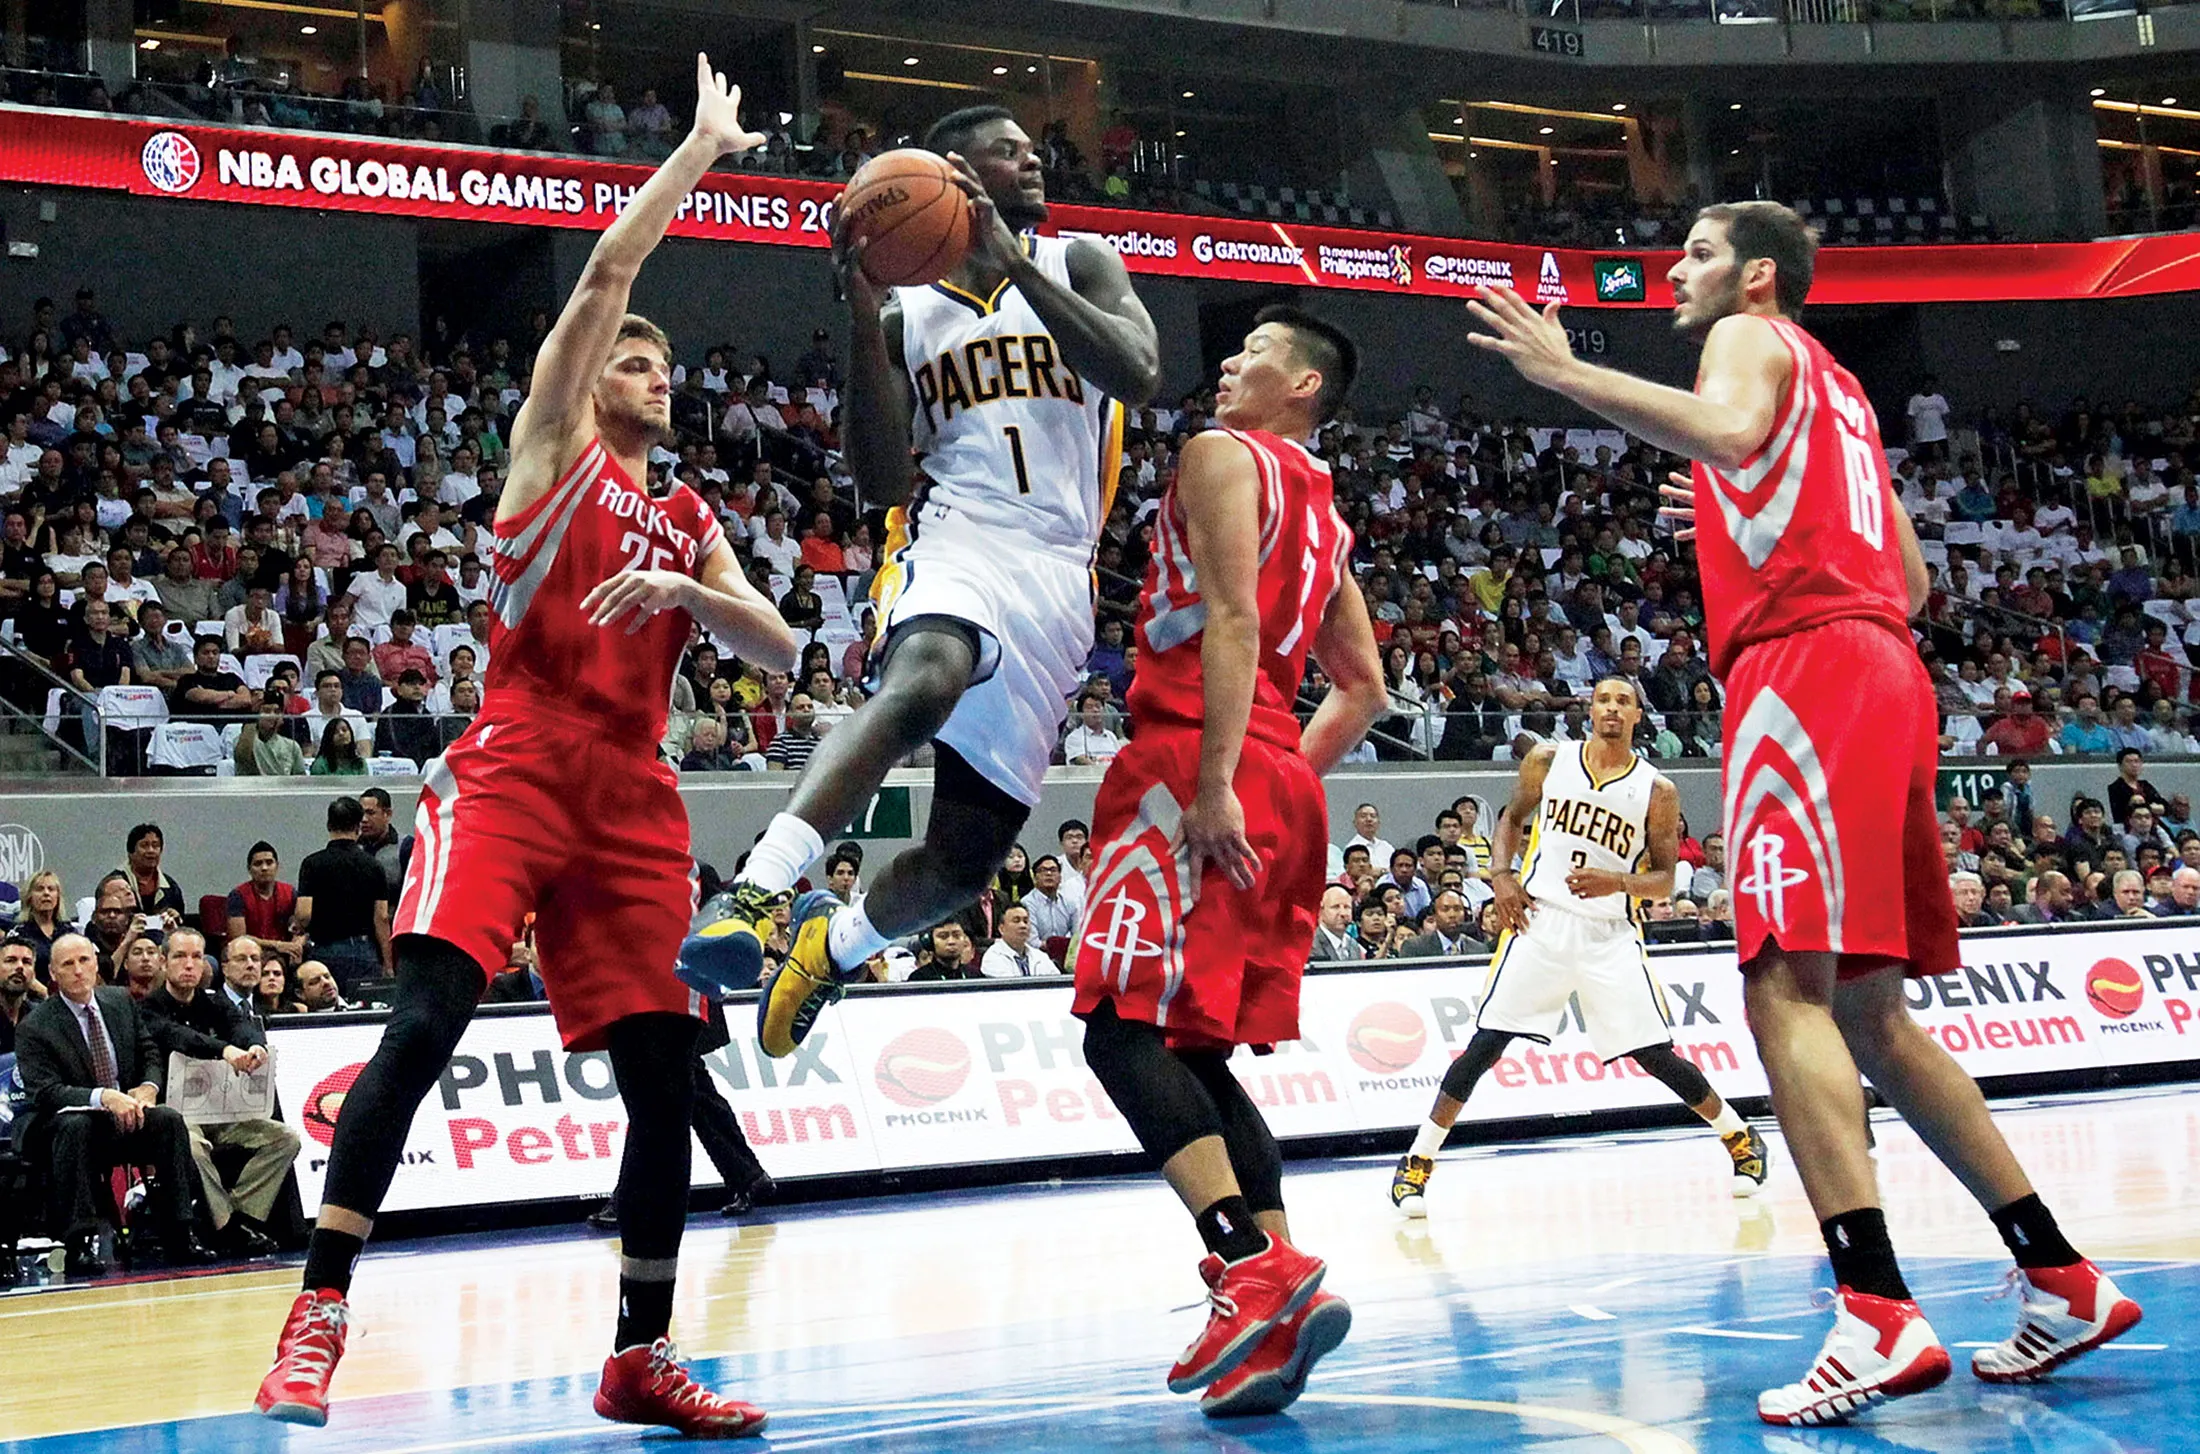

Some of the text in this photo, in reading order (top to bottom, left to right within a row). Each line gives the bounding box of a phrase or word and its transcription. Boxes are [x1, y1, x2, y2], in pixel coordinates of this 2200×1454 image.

[1537, 29, 1579, 55] 419
[218, 149, 304, 191] NBA
[310, 156, 456, 203] GLOBAL
[460, 169, 585, 214] GAMES
[595, 182, 790, 230] PHPPINES
[1108, 231, 1178, 258] adidas
[1216, 243, 1303, 266] GATORADE
[1447, 257, 1512, 277] PHOENIX
[915, 333, 1085, 435] PACERS
[1003, 425, 1031, 495] 1
[1543, 798, 1636, 860] PACERS
[1903, 961, 2066, 1010] OENIX
[2100, 1020, 2165, 1036] PHOENIX
[439, 1032, 842, 1111] PHONIX
[1359, 1074, 1443, 1093] PHOENIX
[448, 1104, 857, 1170] Petrum
[885, 1108, 988, 1128] PHOENIX
